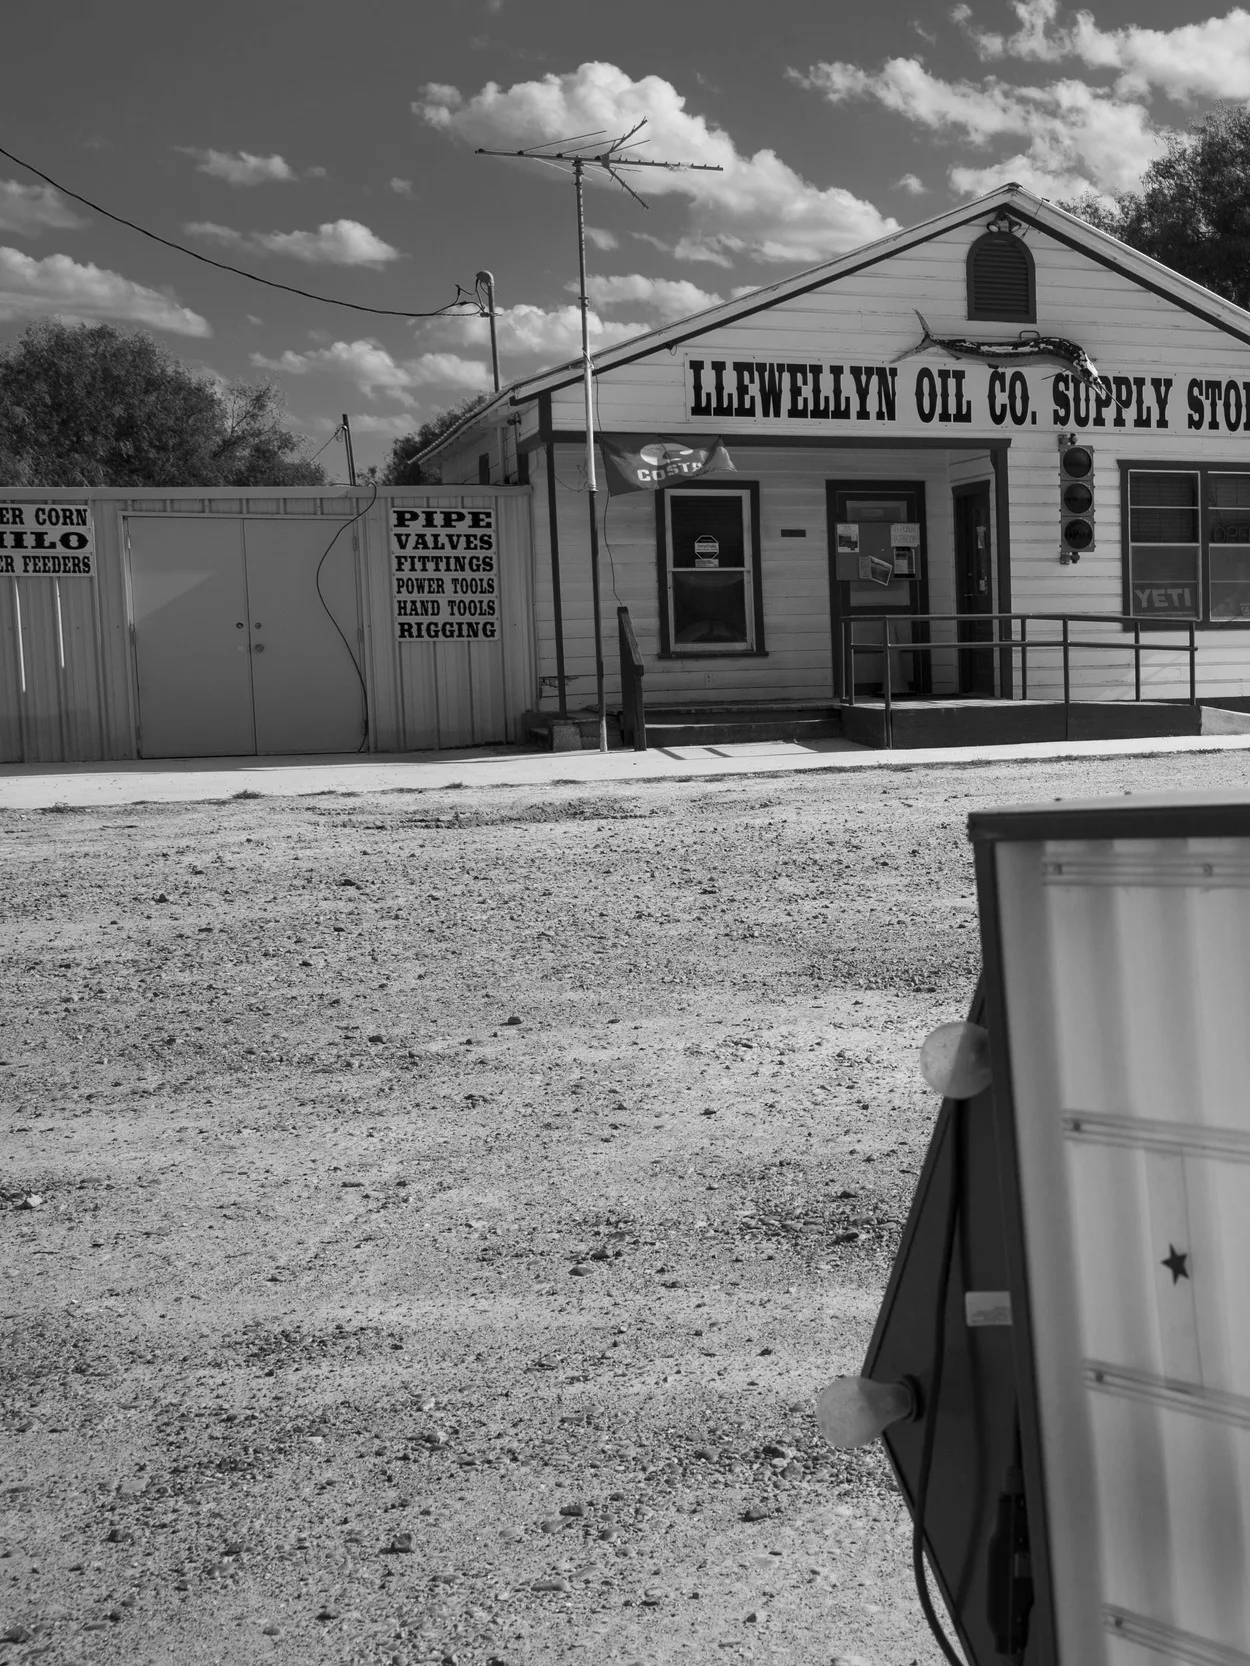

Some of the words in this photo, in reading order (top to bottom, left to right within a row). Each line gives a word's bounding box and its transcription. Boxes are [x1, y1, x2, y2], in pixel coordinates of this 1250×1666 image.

[689, 361, 896, 419] LLEWELLYN
[915, 367, 971, 422] OIL
[988, 370, 1037, 425] CO.
[1053, 373, 1173, 428] SUPPLY
[35, 508, 87, 526] CORN
[393, 511, 492, 528] PIPE
[394, 533, 493, 550] VALVES
[0, 555, 15, 573] R
[22, 556, 91, 574] FEEDERS
[395, 556, 494, 572] FITTINGS
[396, 578, 445, 594] POWER
[452, 578, 495, 594] TOOLS
[1135, 587, 1192, 607] YETI
[397, 600, 440, 616] HAND
[448, 600, 496, 616] TOOLS
[398, 622, 496, 638] RIGGING
